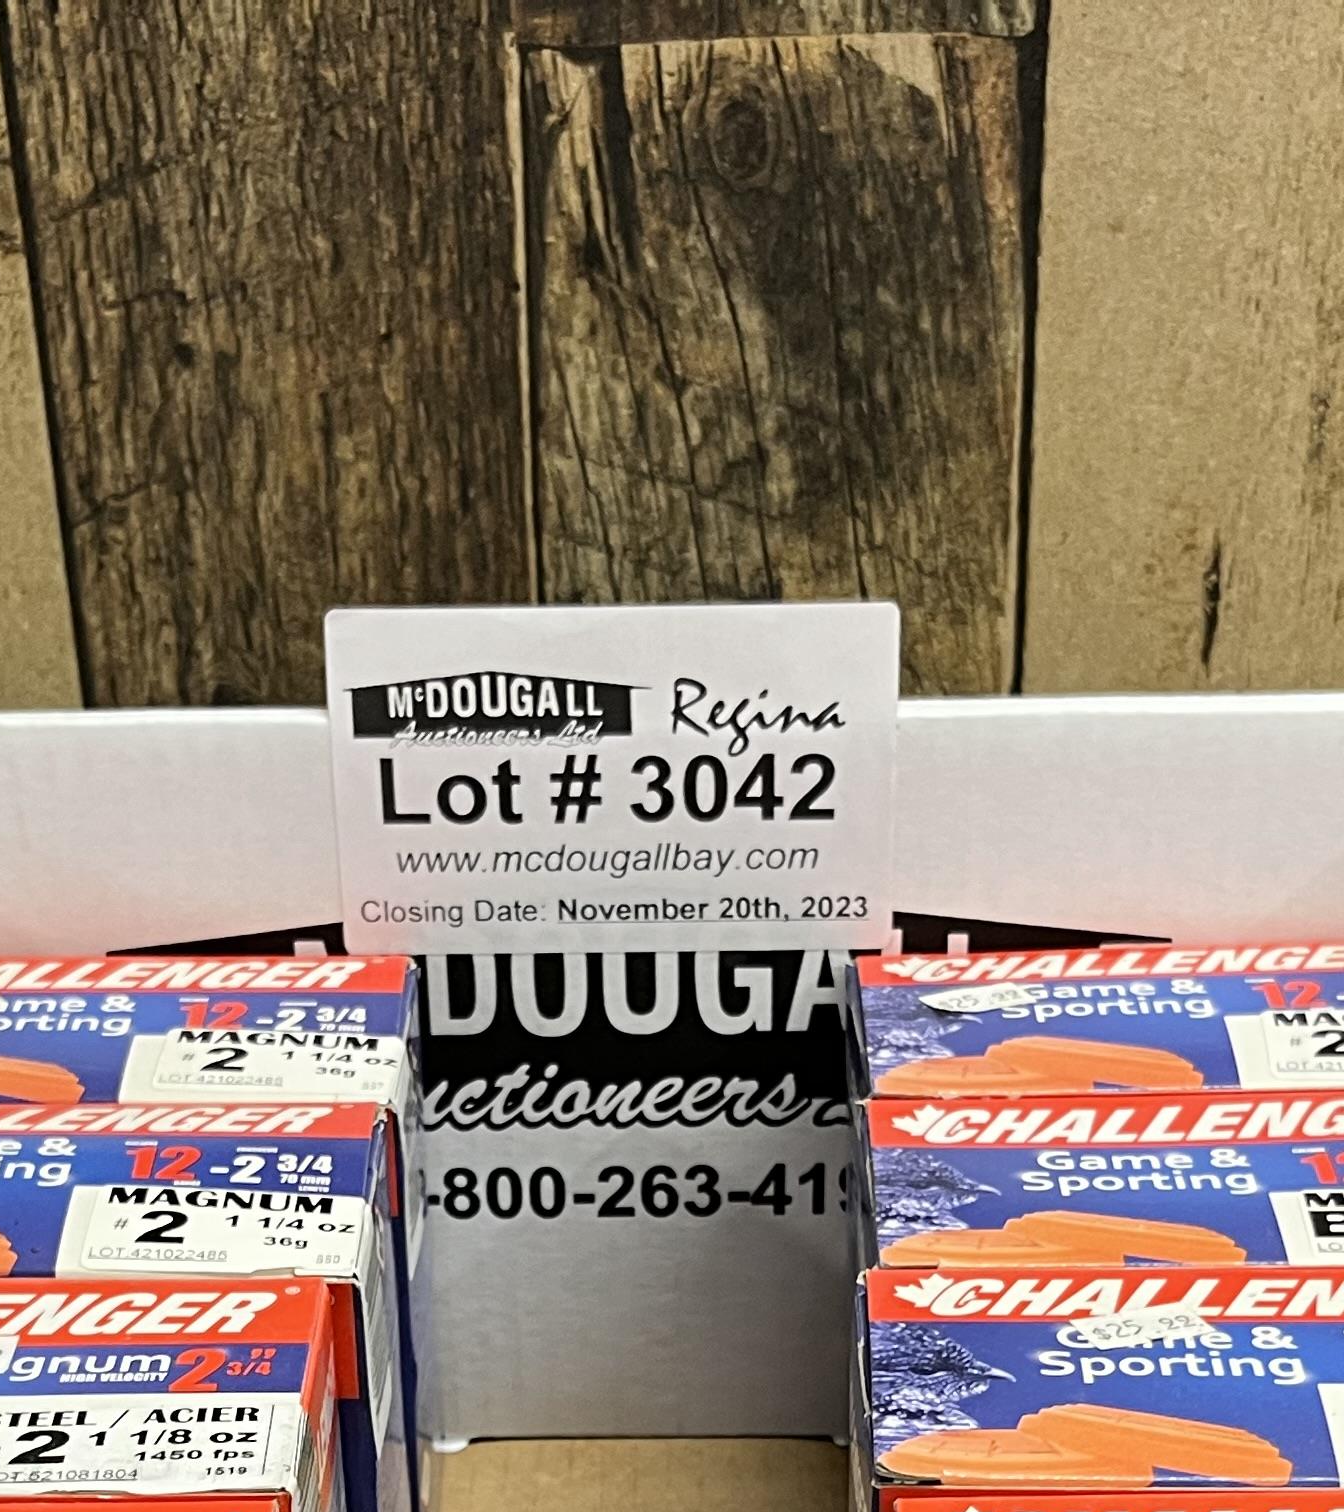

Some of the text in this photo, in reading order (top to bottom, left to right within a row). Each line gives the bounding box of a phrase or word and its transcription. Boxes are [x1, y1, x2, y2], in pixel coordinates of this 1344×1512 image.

[671, 678, 846, 756] Regina
[391, 720, 602, 748] Auctioneers Ltd
[379, 752, 837, 825] Lot # 3042
[396, 843, 820, 880] www.mcdougallbay.com
[360, 896, 869, 927] Closing Date: November 20th, 2023
[426, 951, 849, 1037] DOUGA
[1171, 978, 1207, 996] &
[1251, 981, 1327, 1009] 12
[100, 995, 137, 1013] &
[179, 1001, 367, 1030] 12 3/4
[1001, 994, 1216, 1022] Sporting
[177, 1030, 380, 1052] MAGNUM
[199, 1047, 353, 1073] 2 1/4
[37, 1136, 77, 1157] &
[1036, 1147, 1251, 1172] Game &
[127, 1145, 334, 1181] 12 3/4
[1021, 1166, 1258, 1197] Sporting
[107, 1186, 334, 1215] MAGNUM
[134, 1210, 357, 1244] 2 1/4 oz
[263, 1236, 309, 1250] 36g
[1251, 1326, 1298, 1350] &
[9, 1348, 171, 1383] gnum
[167, 1347, 227, 1393] 2
[1040, 1350, 1307, 1384] Sporting
[142, 1406, 261, 1425] ACIER
[7, 1429, 258, 1466] 2 1/8 oz
[134, 1448, 255, 1463] 1450 fps
